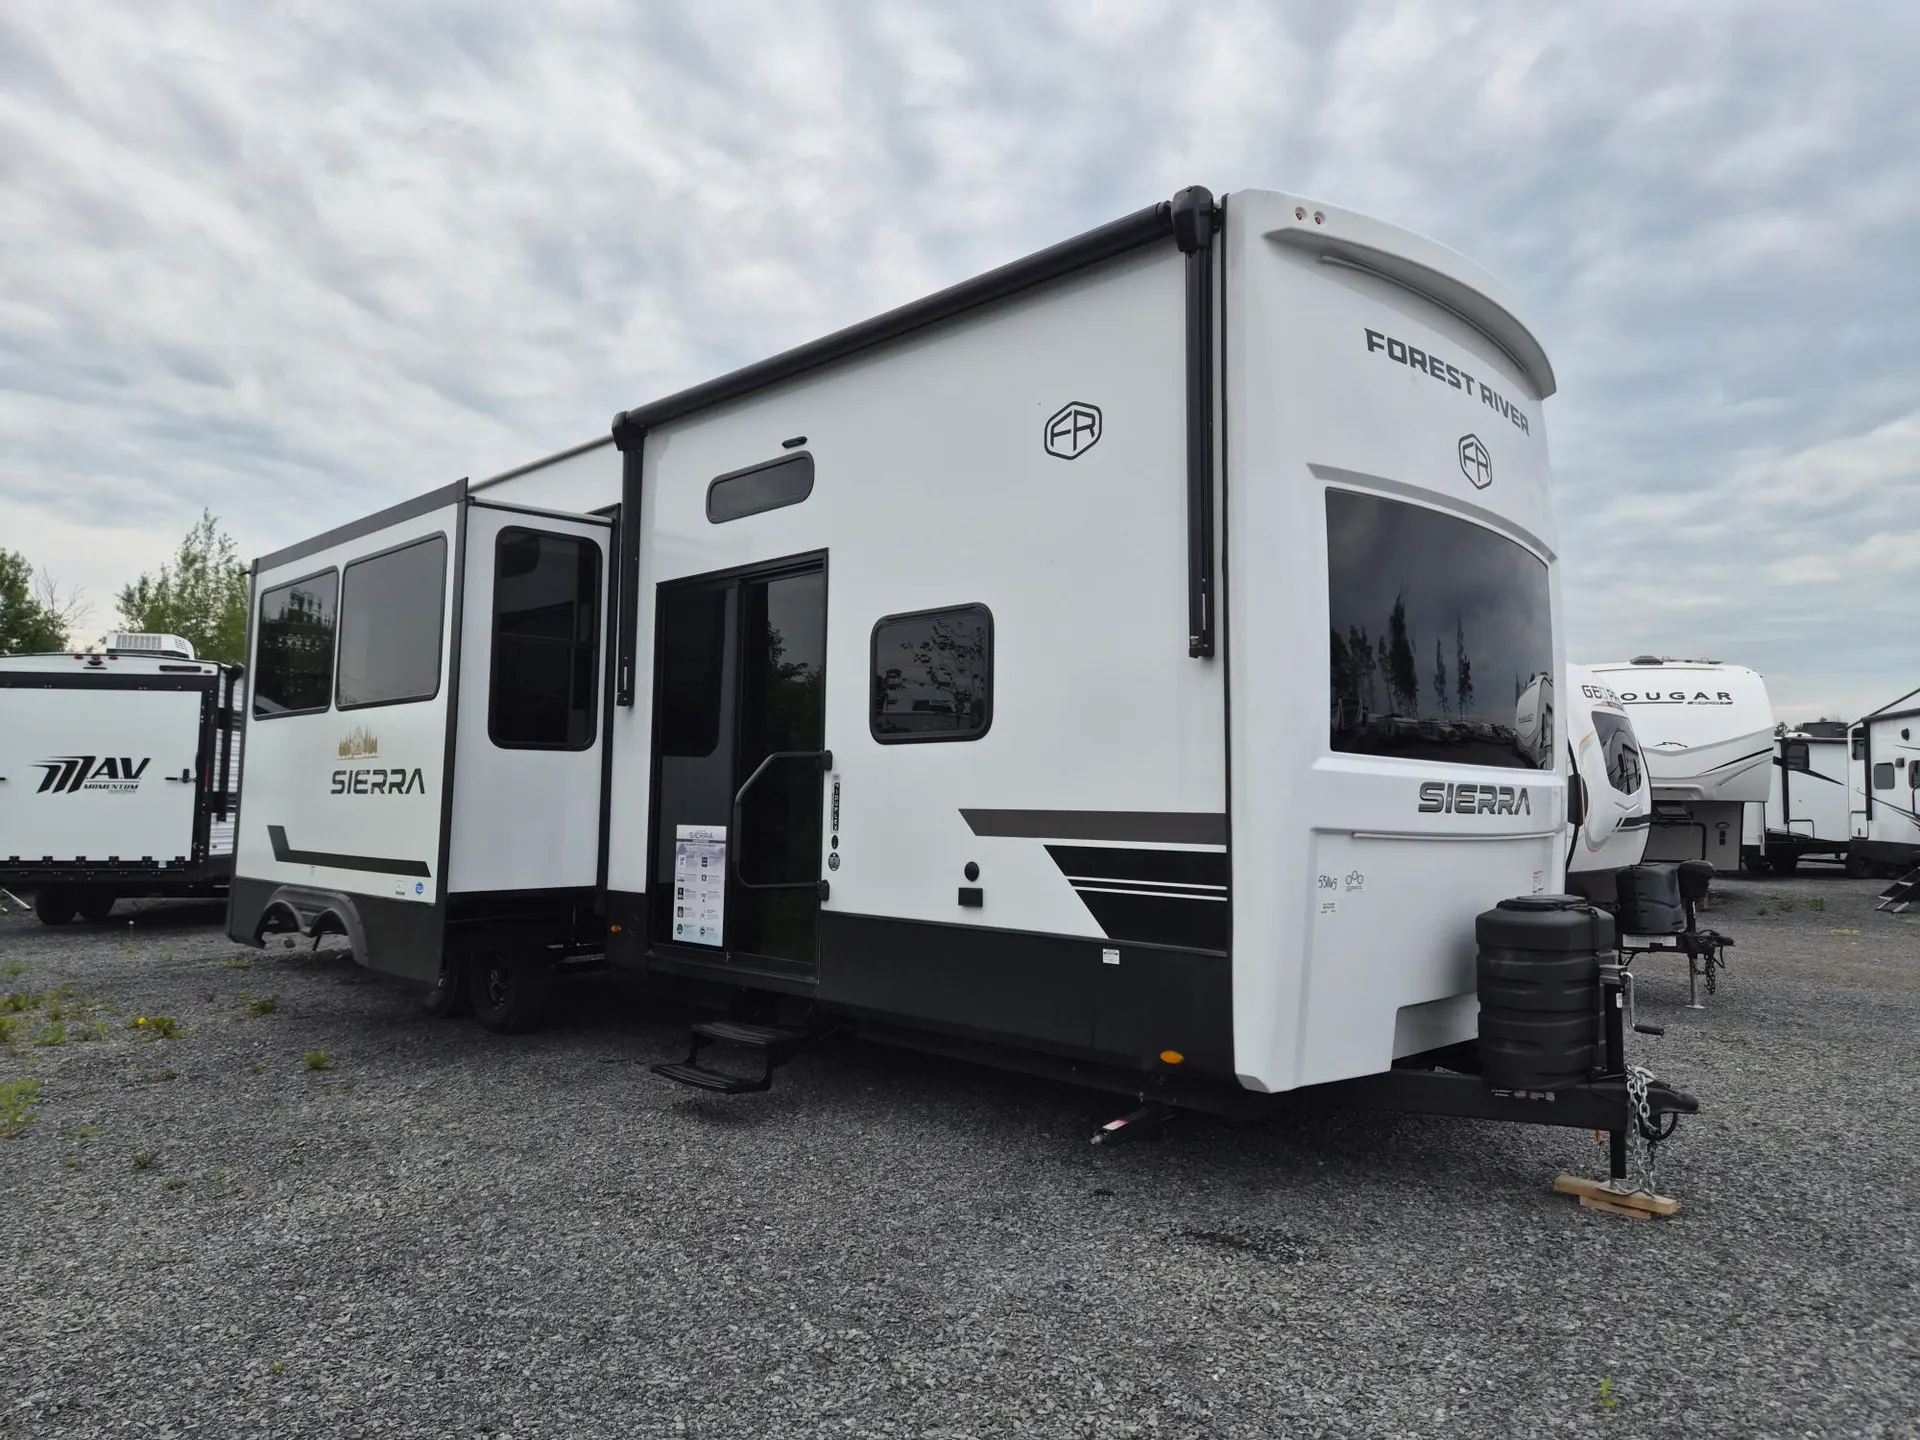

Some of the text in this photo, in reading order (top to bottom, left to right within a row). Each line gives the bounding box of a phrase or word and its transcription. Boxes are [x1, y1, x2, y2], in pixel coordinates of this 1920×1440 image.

[1364, 328, 1530, 437] FOREST RIVER
[1620, 691, 1733, 701] OUGAR
[330, 768, 425, 795] SIERRA
[1418, 781, 1531, 816] SIERRA
